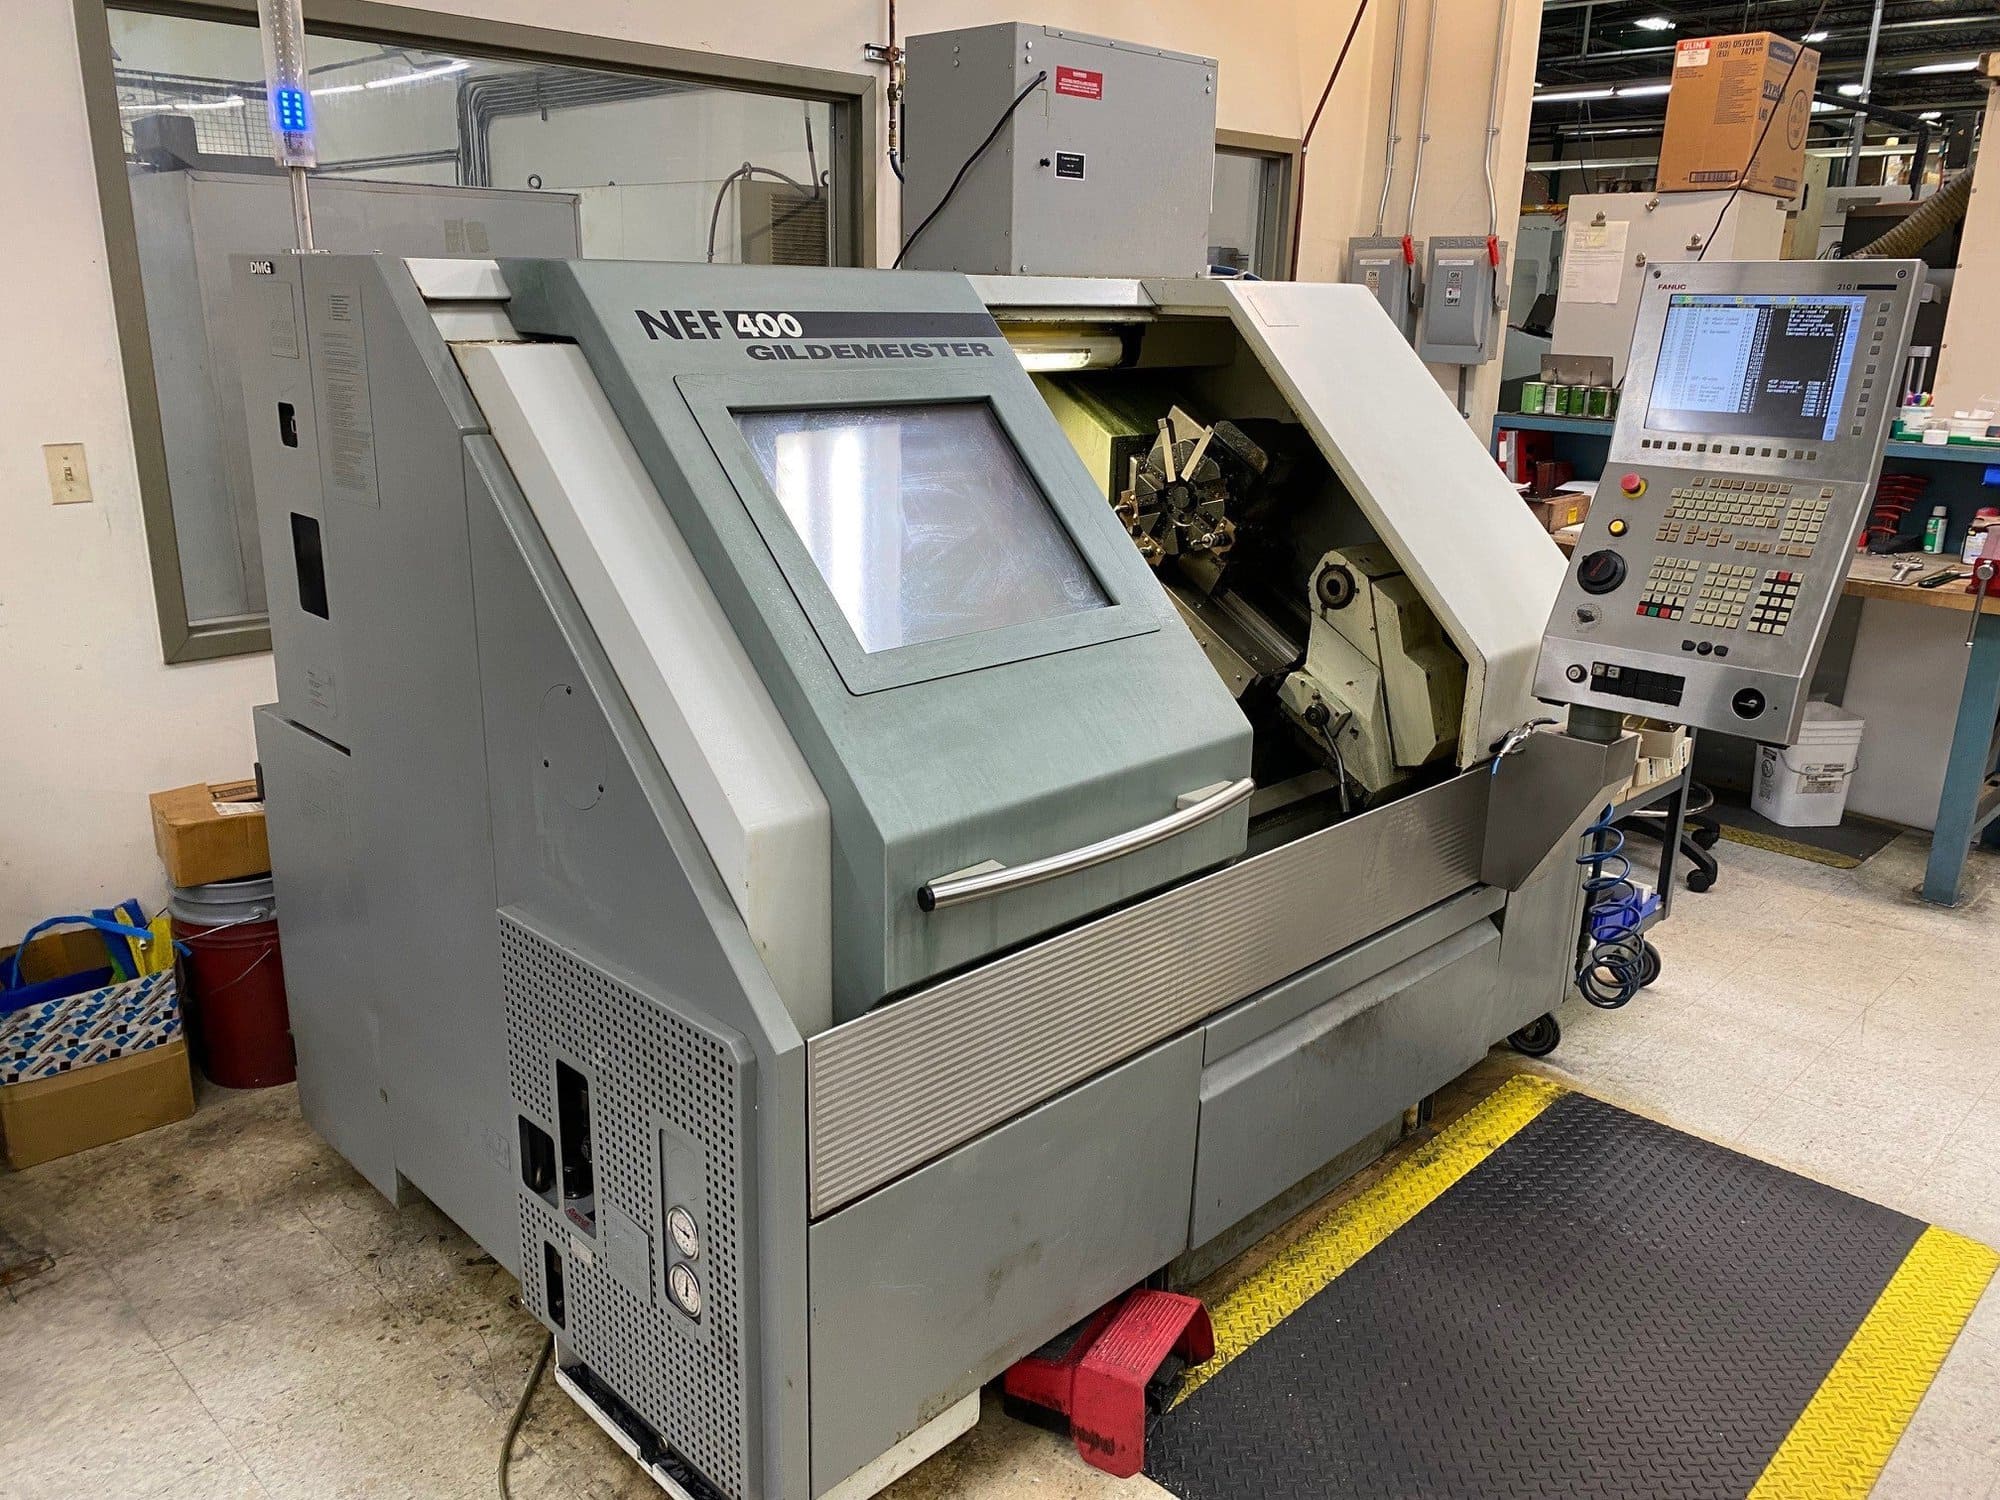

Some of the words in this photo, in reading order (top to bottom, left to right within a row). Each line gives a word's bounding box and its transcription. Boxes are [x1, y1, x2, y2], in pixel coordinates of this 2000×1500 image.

[249, 261, 273, 274] DMG
[635, 310, 723, 340] NEF
[736, 313, 804, 339] 400
[745, 343, 995, 361] GILDEMEISTER
